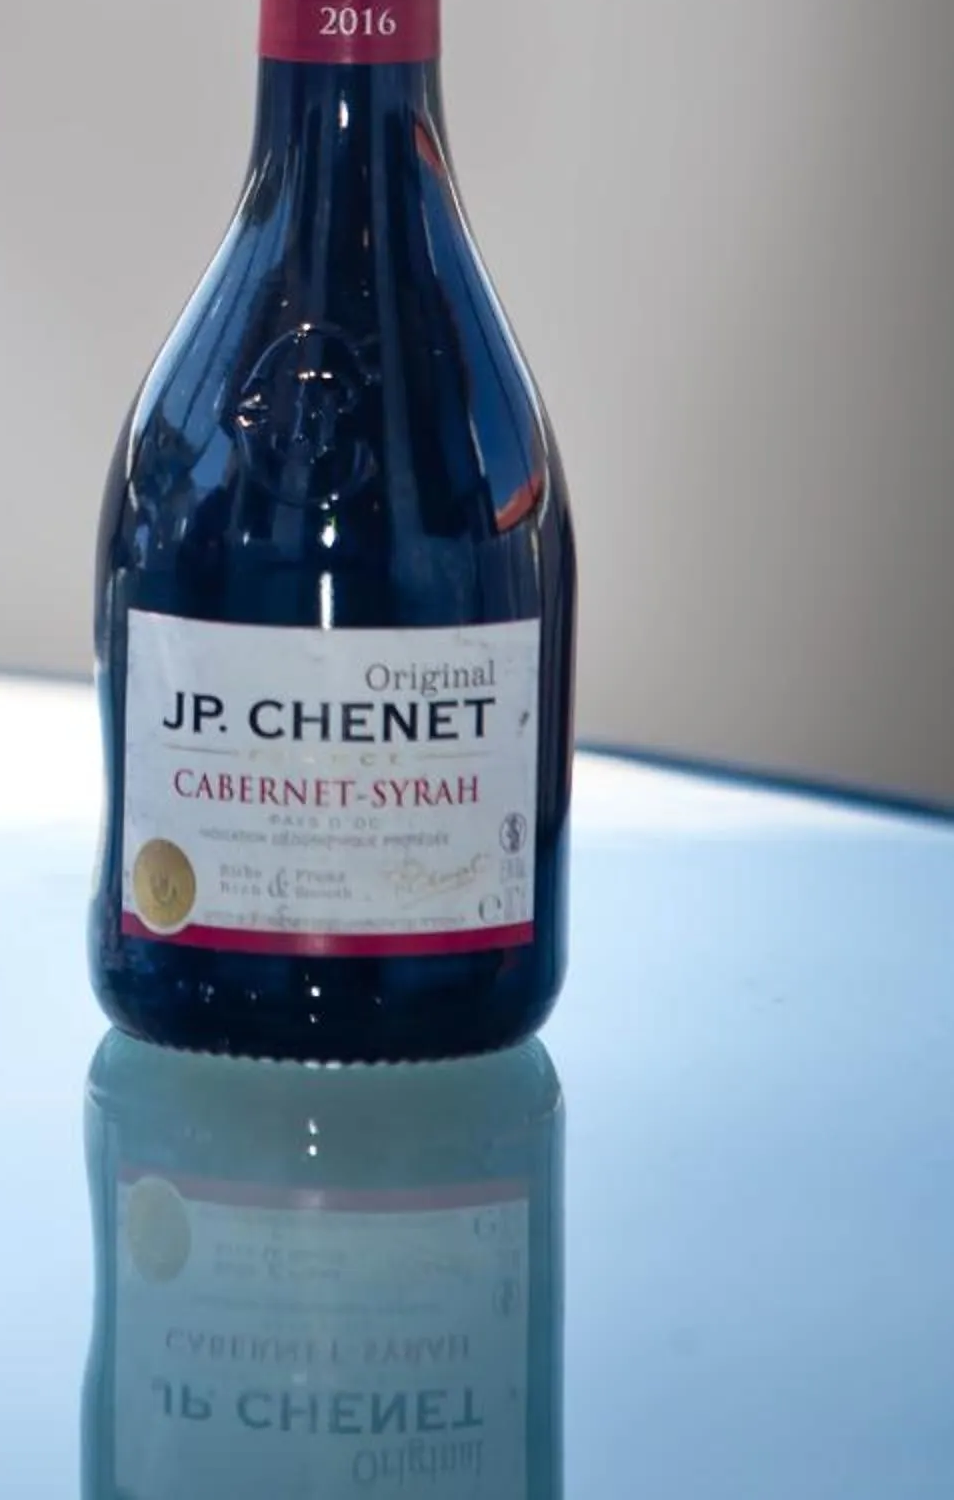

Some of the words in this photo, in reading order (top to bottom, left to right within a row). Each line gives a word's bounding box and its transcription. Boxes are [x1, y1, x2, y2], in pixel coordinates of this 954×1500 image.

[319, 7, 397, 37] 2016
[364, 660, 497, 698] Original
[162, 691, 228, 734] JP.
[248, 697, 496, 743] CHENET
[173, 768, 481, 809] CABERNET-SYRAH
